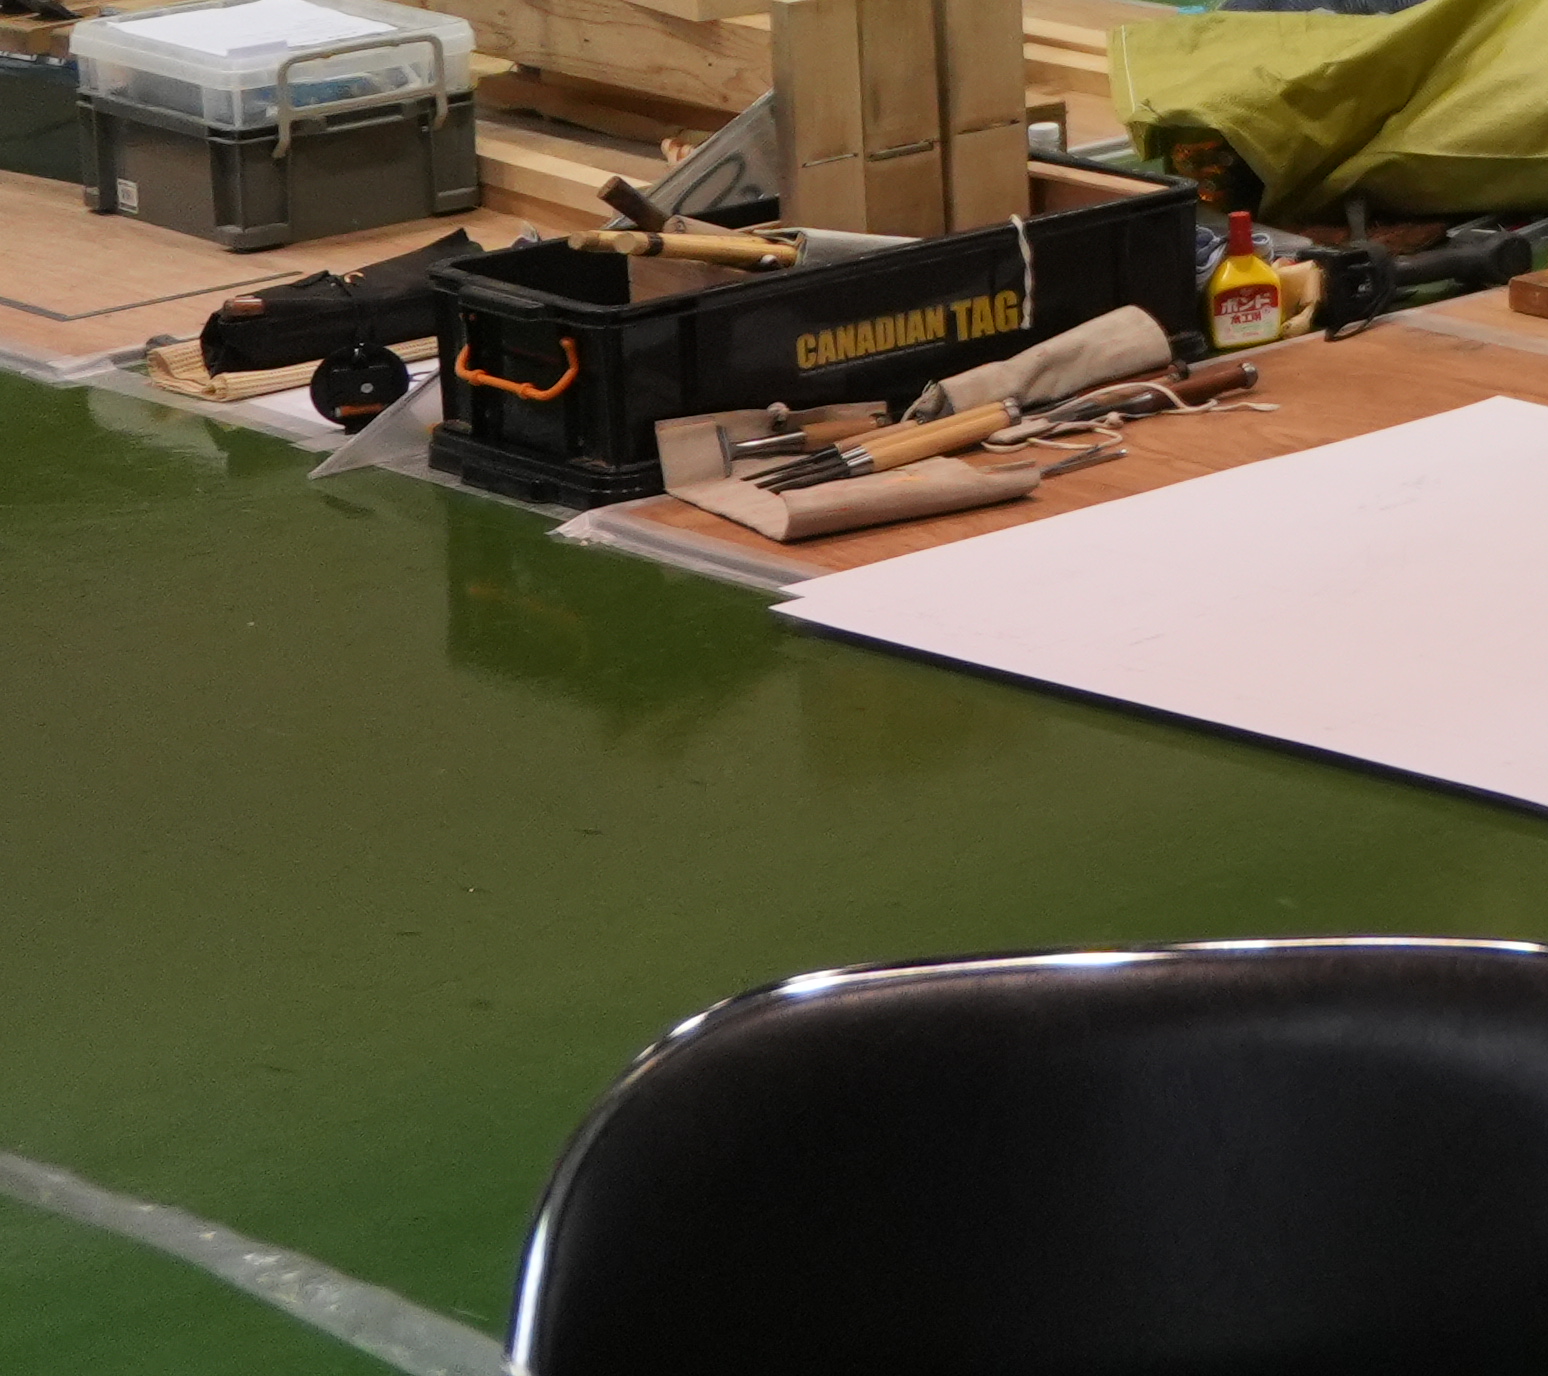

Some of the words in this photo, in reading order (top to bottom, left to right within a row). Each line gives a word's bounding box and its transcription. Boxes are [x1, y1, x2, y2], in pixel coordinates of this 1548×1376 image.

[1221, 292, 1271, 314] ボンド
[796, 304, 947, 370] CANADIAN
[950, 290, 1020, 342] TAG
